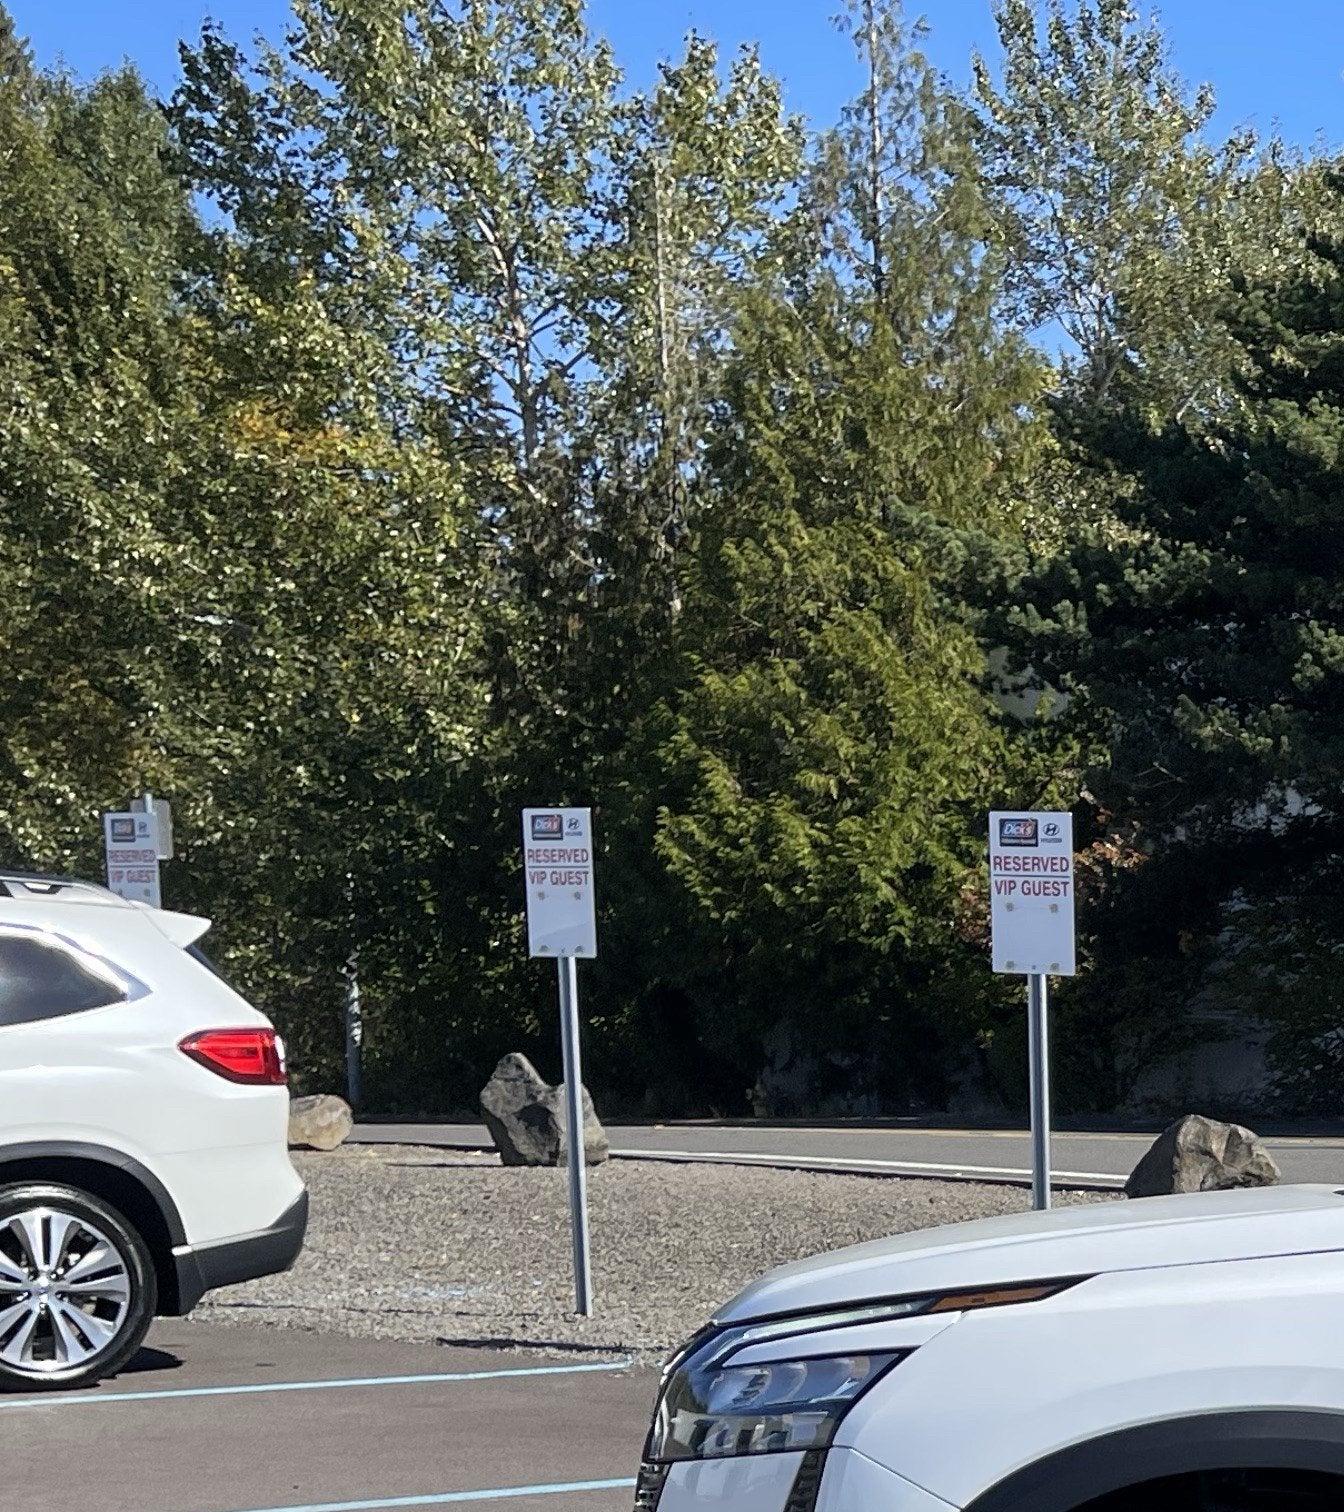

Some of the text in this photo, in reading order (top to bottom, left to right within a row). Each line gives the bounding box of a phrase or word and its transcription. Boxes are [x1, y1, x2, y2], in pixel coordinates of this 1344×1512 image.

[527, 849, 589, 863] RESERVED
[993, 856, 1070, 872] RESERVED
[529, 871, 589, 885] VIP GUEST
[994, 880, 1070, 897] VIP GUEST
